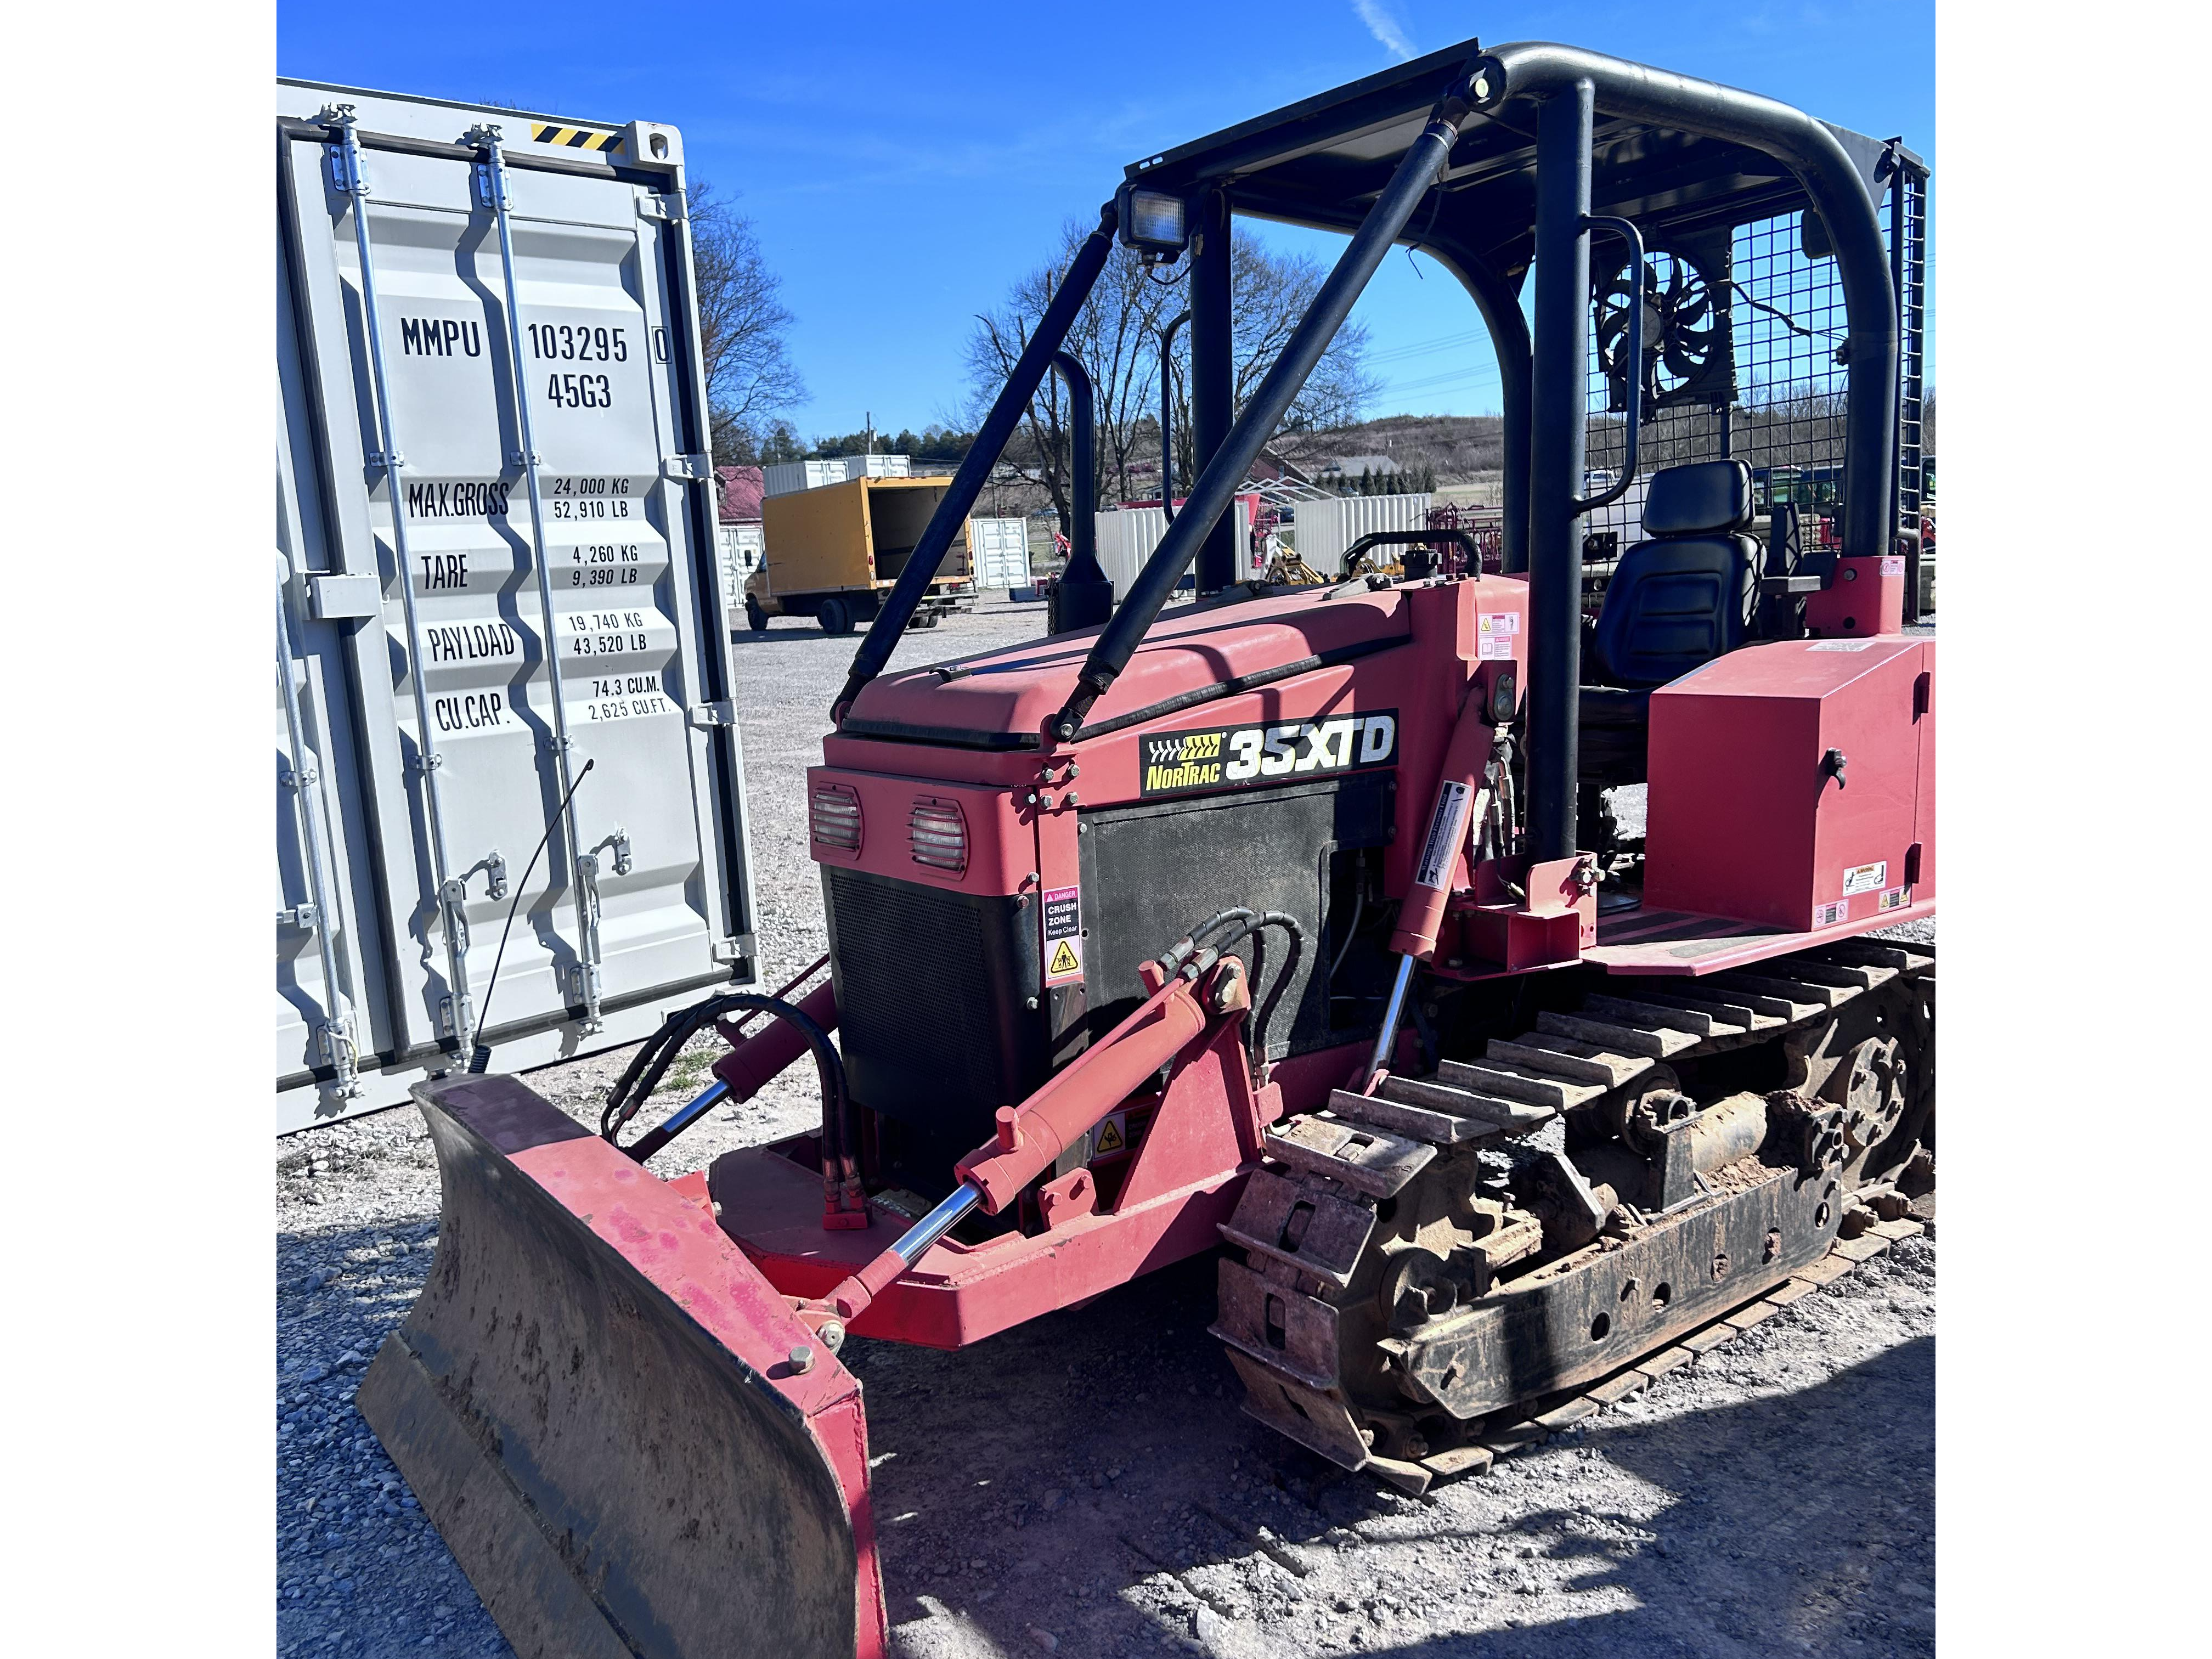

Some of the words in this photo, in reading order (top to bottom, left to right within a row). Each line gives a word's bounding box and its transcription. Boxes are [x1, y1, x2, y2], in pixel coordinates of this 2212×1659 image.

[401, 318, 482, 357] MMPU
[528, 324, 628, 362] 103295
[654, 329, 669, 362] 0
[548, 374, 612, 408] 45G3
[409, 482, 509, 518] MAX.GROSS
[555, 478, 605, 495] 24,000
[611, 478, 629, 494] KG
[555, 501, 605, 520] 52,910
[612, 502, 628, 518] LB
[421, 555, 468, 589] TARE
[573, 545, 614, 564] 4,260
[620, 545, 639, 561] KG
[573, 568, 614, 587] 9,390
[621, 568, 637, 584] LB
[427, 624, 515, 662] PAYLOAD
[568, 614, 619, 632] 19,740
[625, 612, 643, 628] KG
[574, 637, 623, 655] 43,520
[631, 635, 647, 651] LB
[436, 693, 511, 731] CU.CAP.
[593, 680, 622, 697] 74.3
[628, 676, 659, 693] CU.M.
[589, 702, 628, 721] 2,625
[633, 698, 672, 715] CU.FT.
[1226, 716, 1395, 780] 35XTD
[1054, 890, 1076, 900] DANGER
[1048, 902, 1077, 915] CRUSH
[1048, 915, 1071, 926] ZONE
[1063, 926, 1077, 934] Clear
